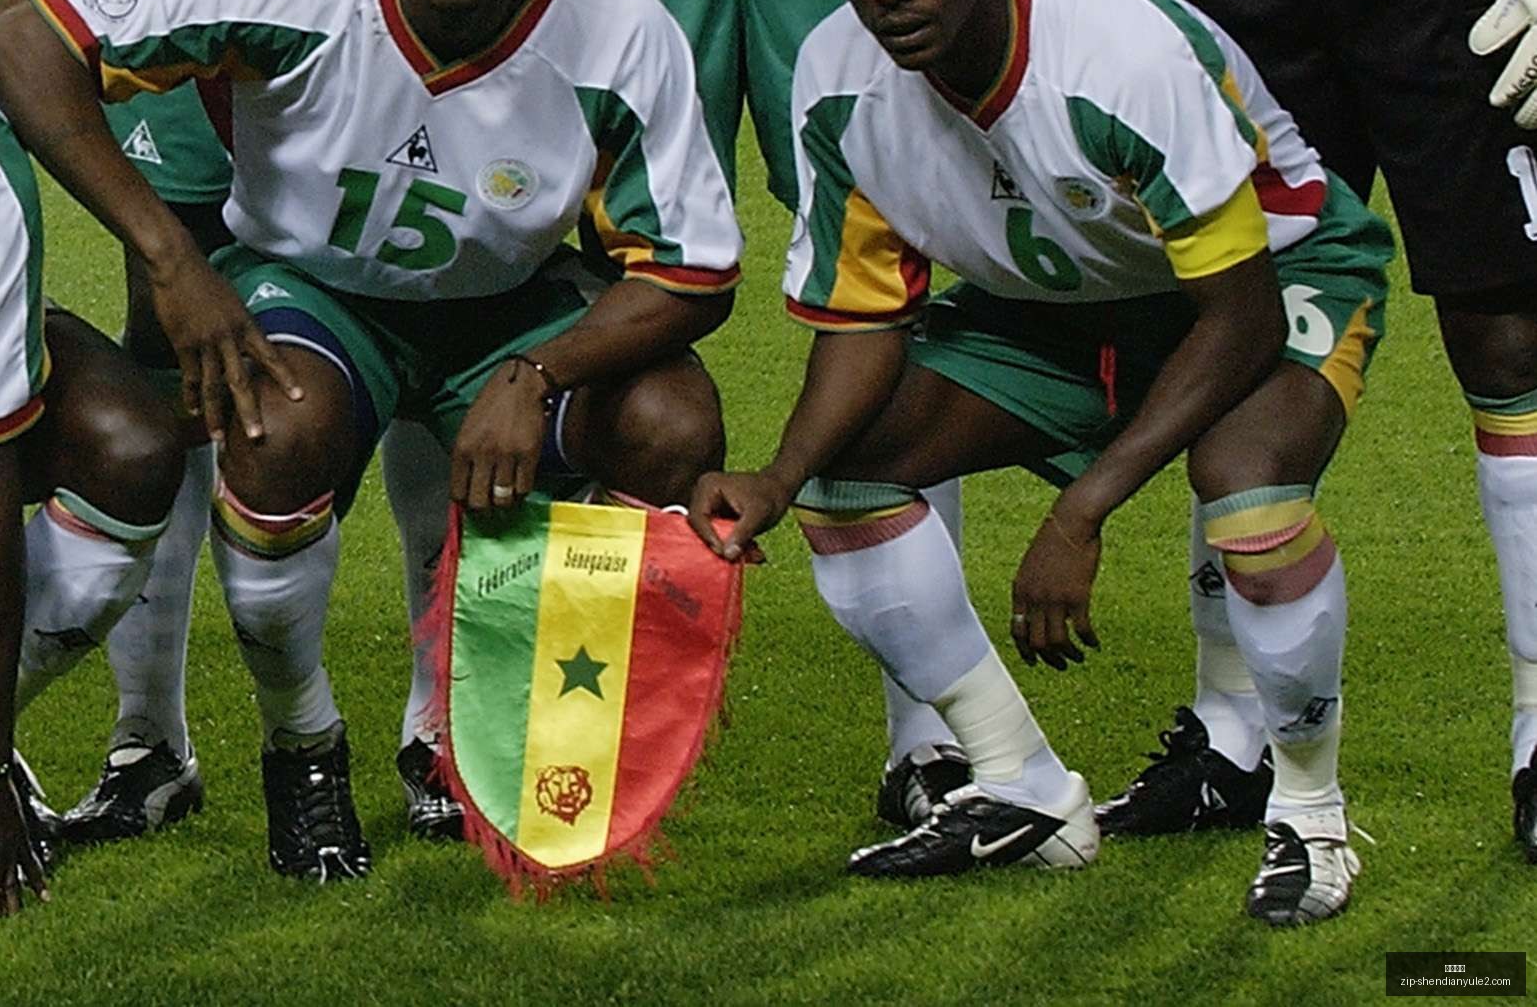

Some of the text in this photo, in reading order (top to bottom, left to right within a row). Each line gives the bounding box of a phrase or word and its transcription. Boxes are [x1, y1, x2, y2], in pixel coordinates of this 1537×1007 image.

[327, 167, 468, 271] 15
[1006, 207, 1083, 292] 6
[1282, 284, 1334, 357] 6
